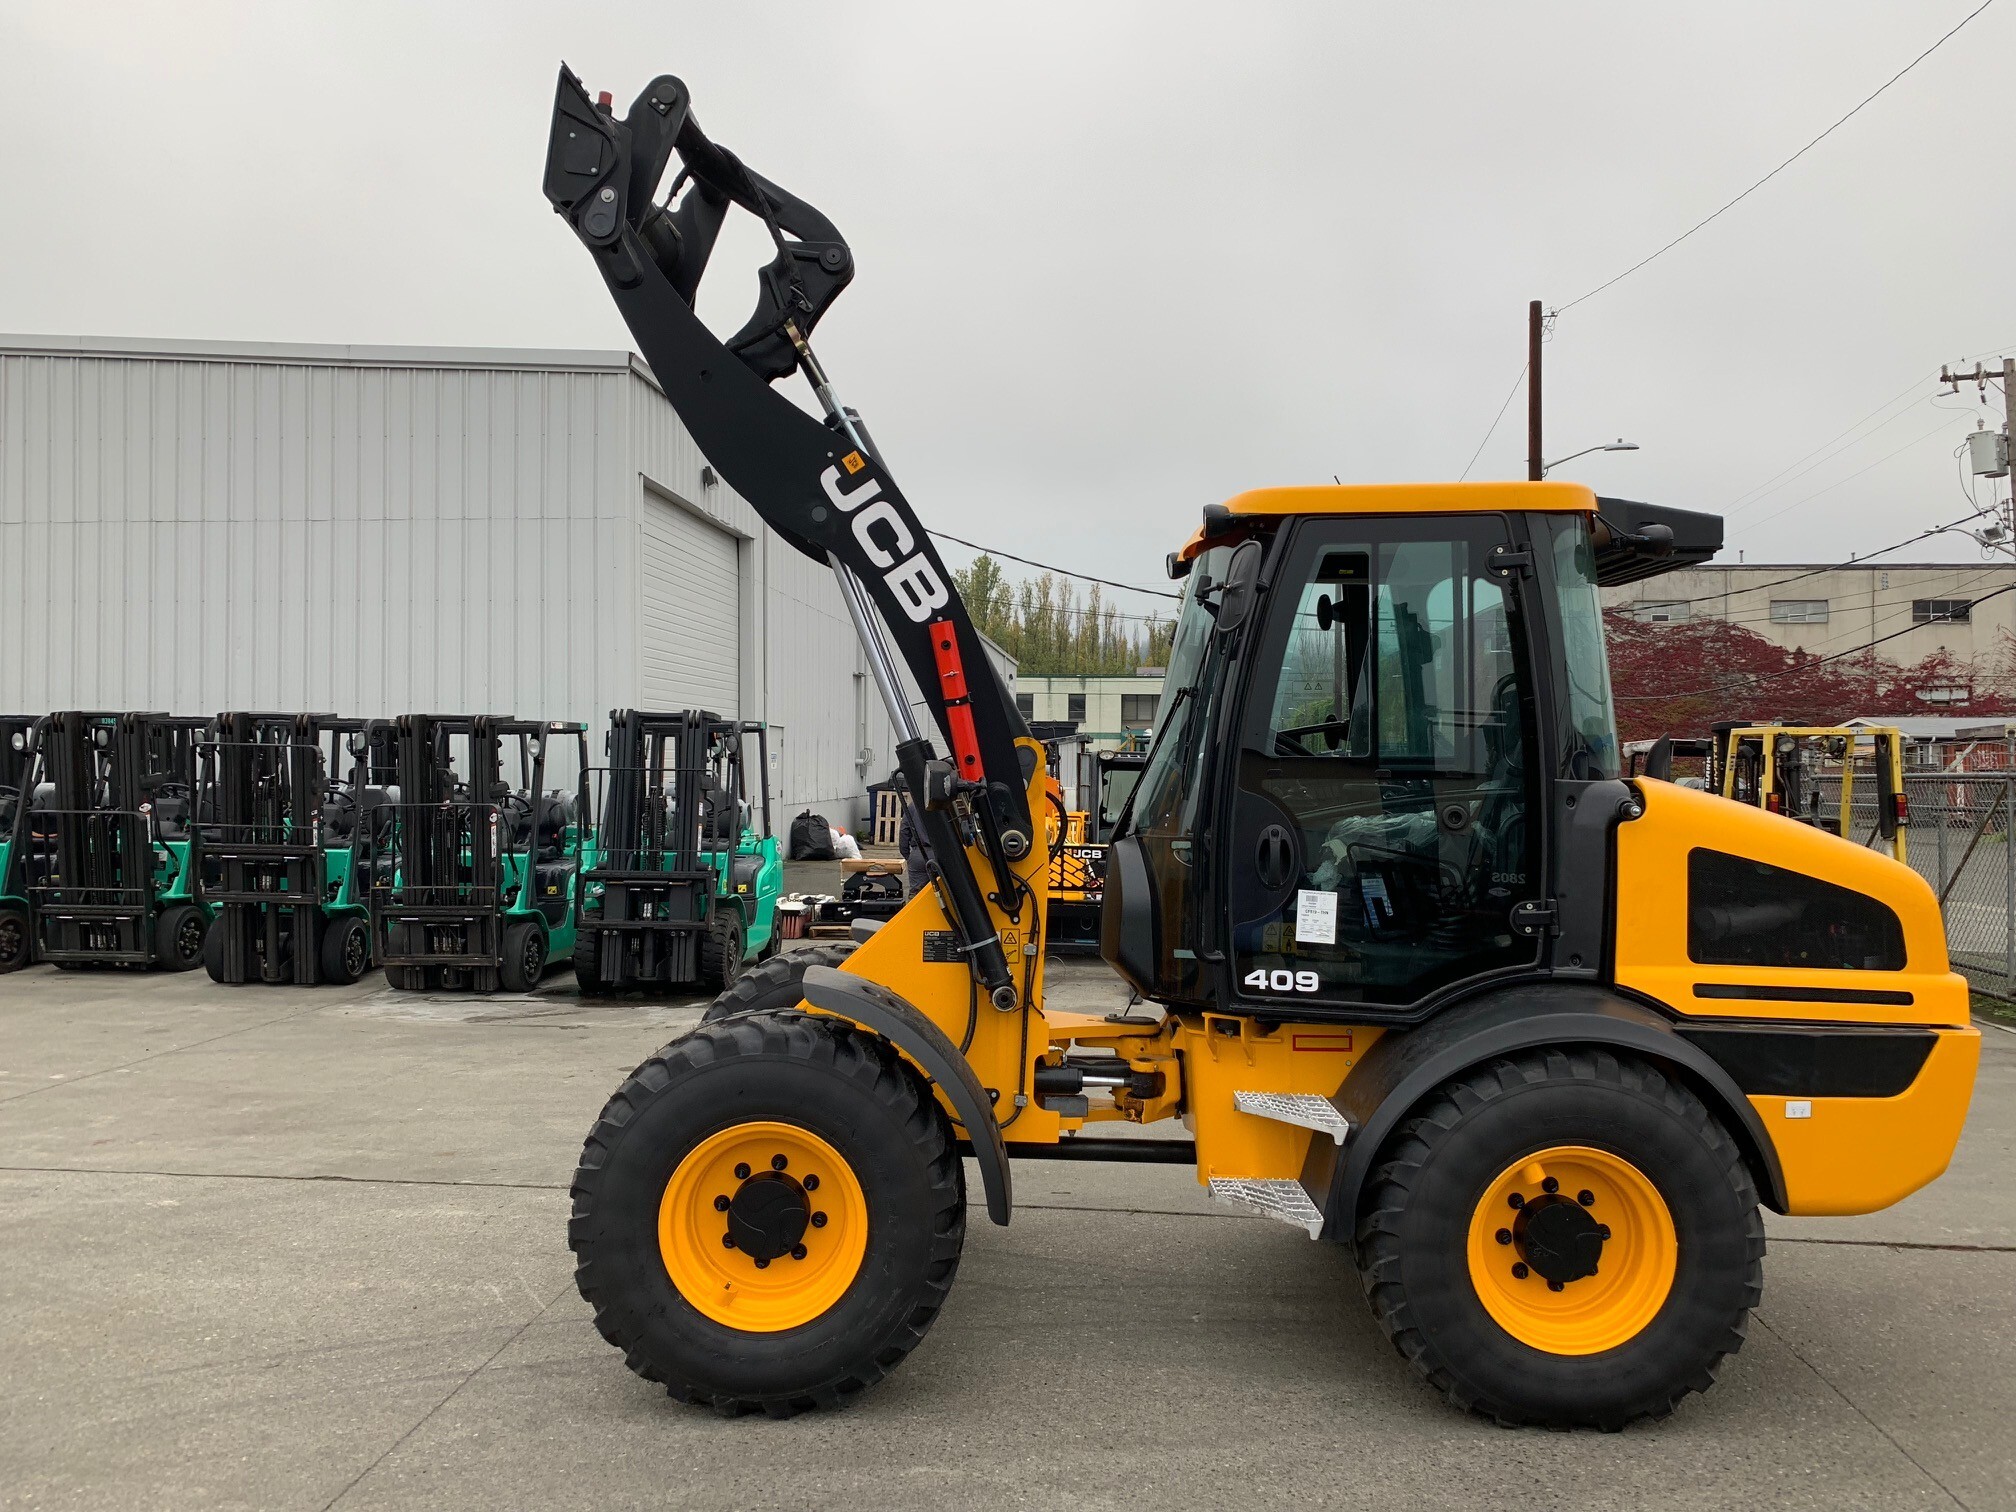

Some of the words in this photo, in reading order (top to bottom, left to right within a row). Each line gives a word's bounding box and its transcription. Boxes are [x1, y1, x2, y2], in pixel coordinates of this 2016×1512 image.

[820, 464, 949, 623] JCB
[1073, 849, 1102, 858] JCB
[1244, 969, 1319, 992] 409
